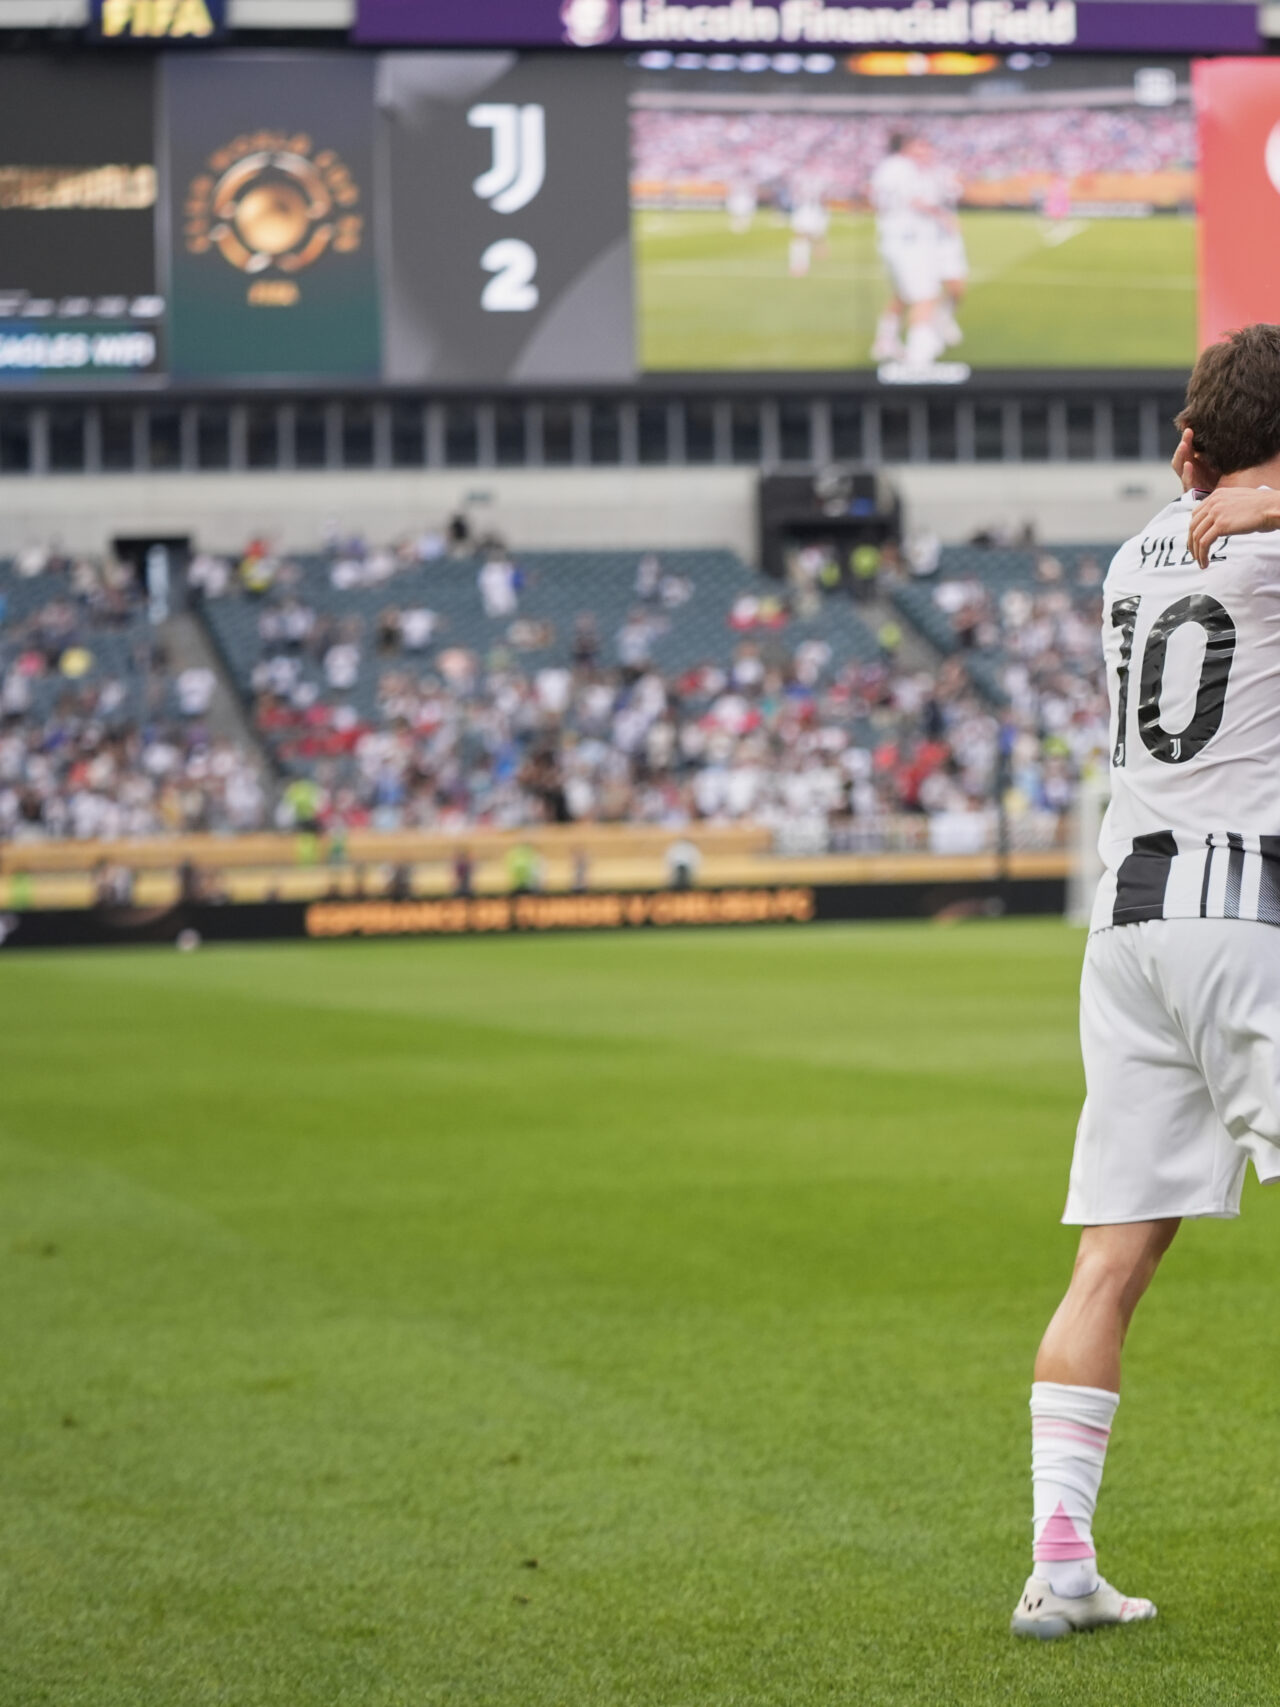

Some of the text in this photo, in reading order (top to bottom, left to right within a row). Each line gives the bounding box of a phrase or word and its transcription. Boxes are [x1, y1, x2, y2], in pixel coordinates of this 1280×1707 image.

[102, 0, 214, 37] FIFA
[620, 0, 1076, 45] Lincoln Financial Field
[481, 238, 539, 312] 2
[1111, 594, 1238, 768] 10
